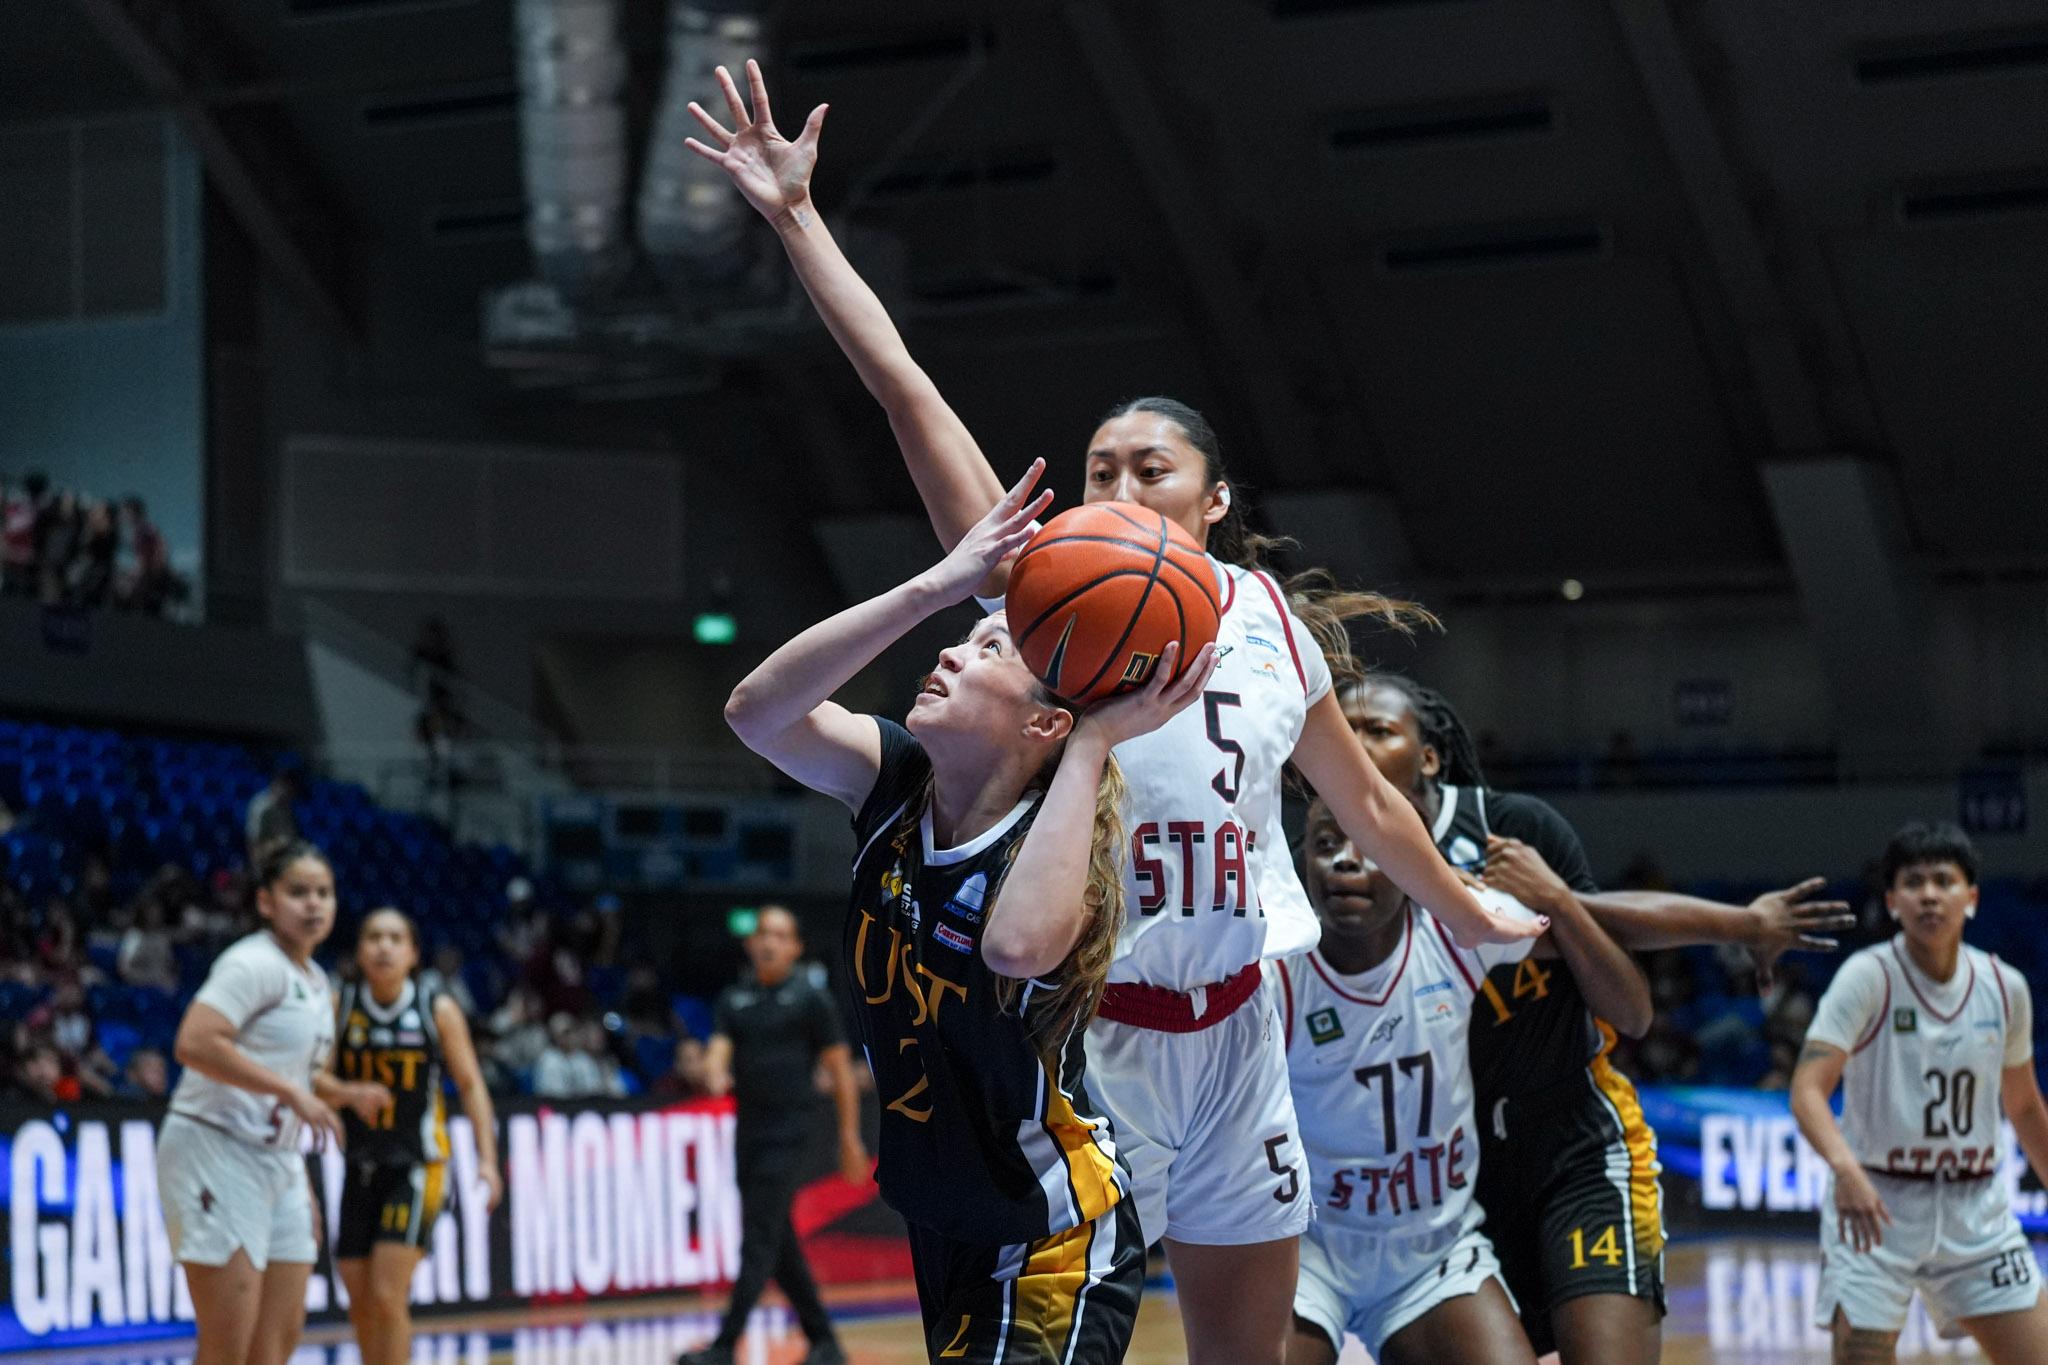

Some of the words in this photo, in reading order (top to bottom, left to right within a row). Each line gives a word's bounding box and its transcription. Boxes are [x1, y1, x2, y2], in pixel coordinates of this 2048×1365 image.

[1203, 690, 1244, 803] 5
[1132, 821, 1265, 918] STA
[855, 909, 967, 1027] UST
[887, 1038, 933, 1122] 2
[1354, 1050, 1433, 1155] 77
[1924, 1067, 1976, 1137] 20
[508, 1111, 743, 1297] MOMEN
[1264, 1134, 1298, 1203] 5
[1327, 1126, 1467, 1216] STATE
[1701, 1113, 1827, 1211] EVER
[10, 1118, 196, 1336] GAM
[1568, 1225, 1623, 1269] 14
[1991, 1248, 2030, 1289] 20
